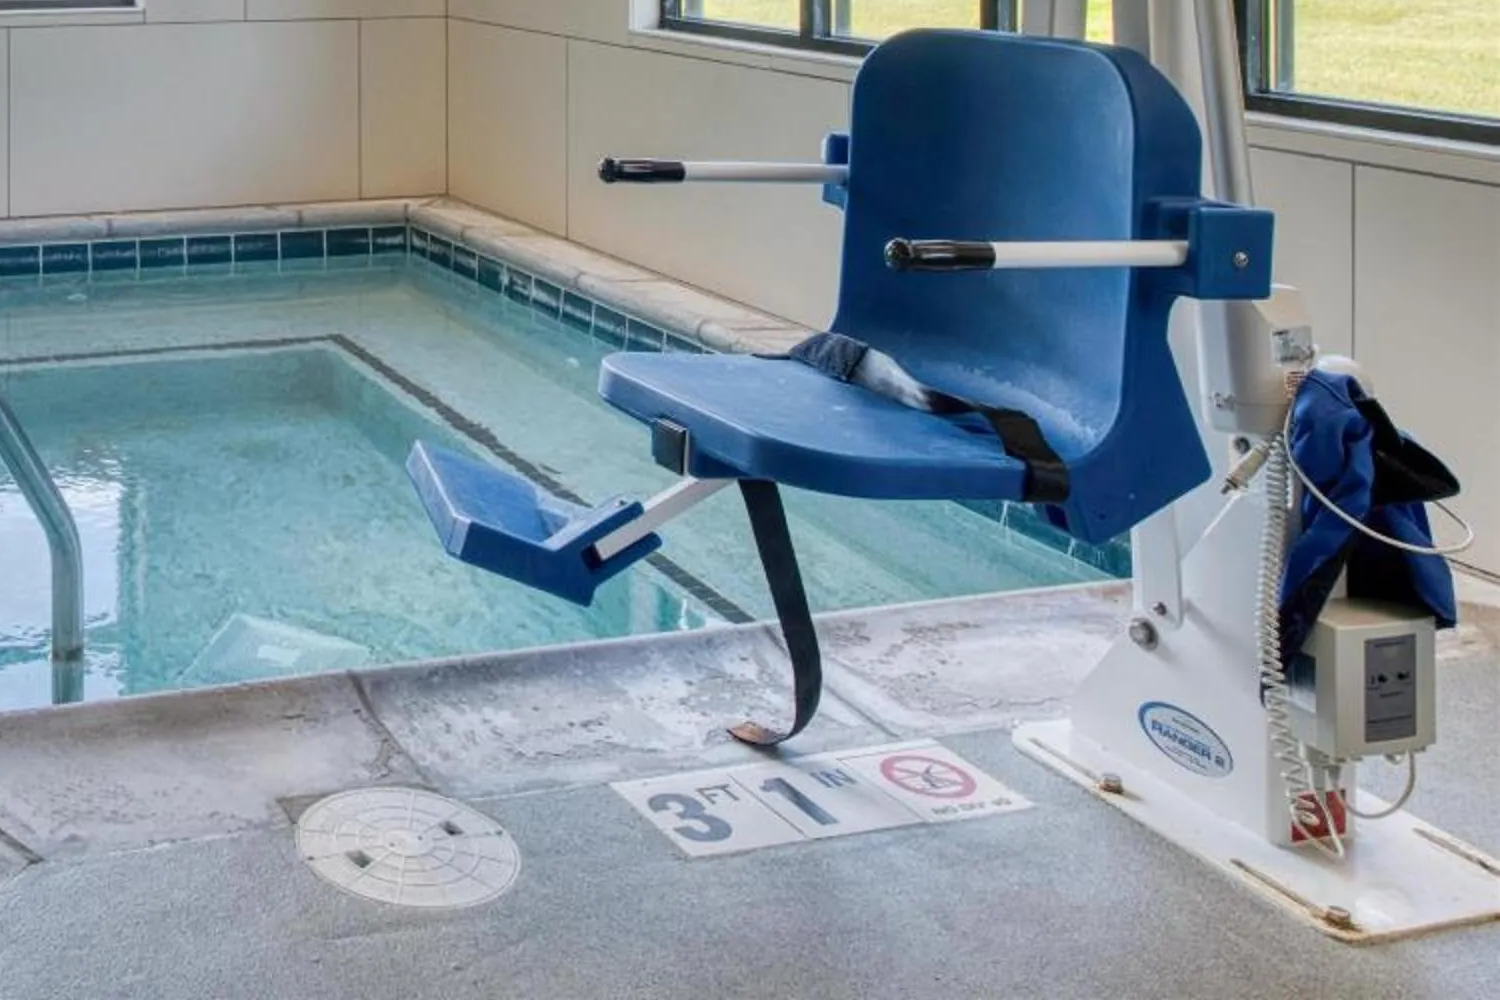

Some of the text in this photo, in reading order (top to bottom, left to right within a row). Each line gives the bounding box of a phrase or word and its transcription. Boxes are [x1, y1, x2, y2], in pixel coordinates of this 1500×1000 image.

[648, 768, 858, 842] 3 FT 1 IN
